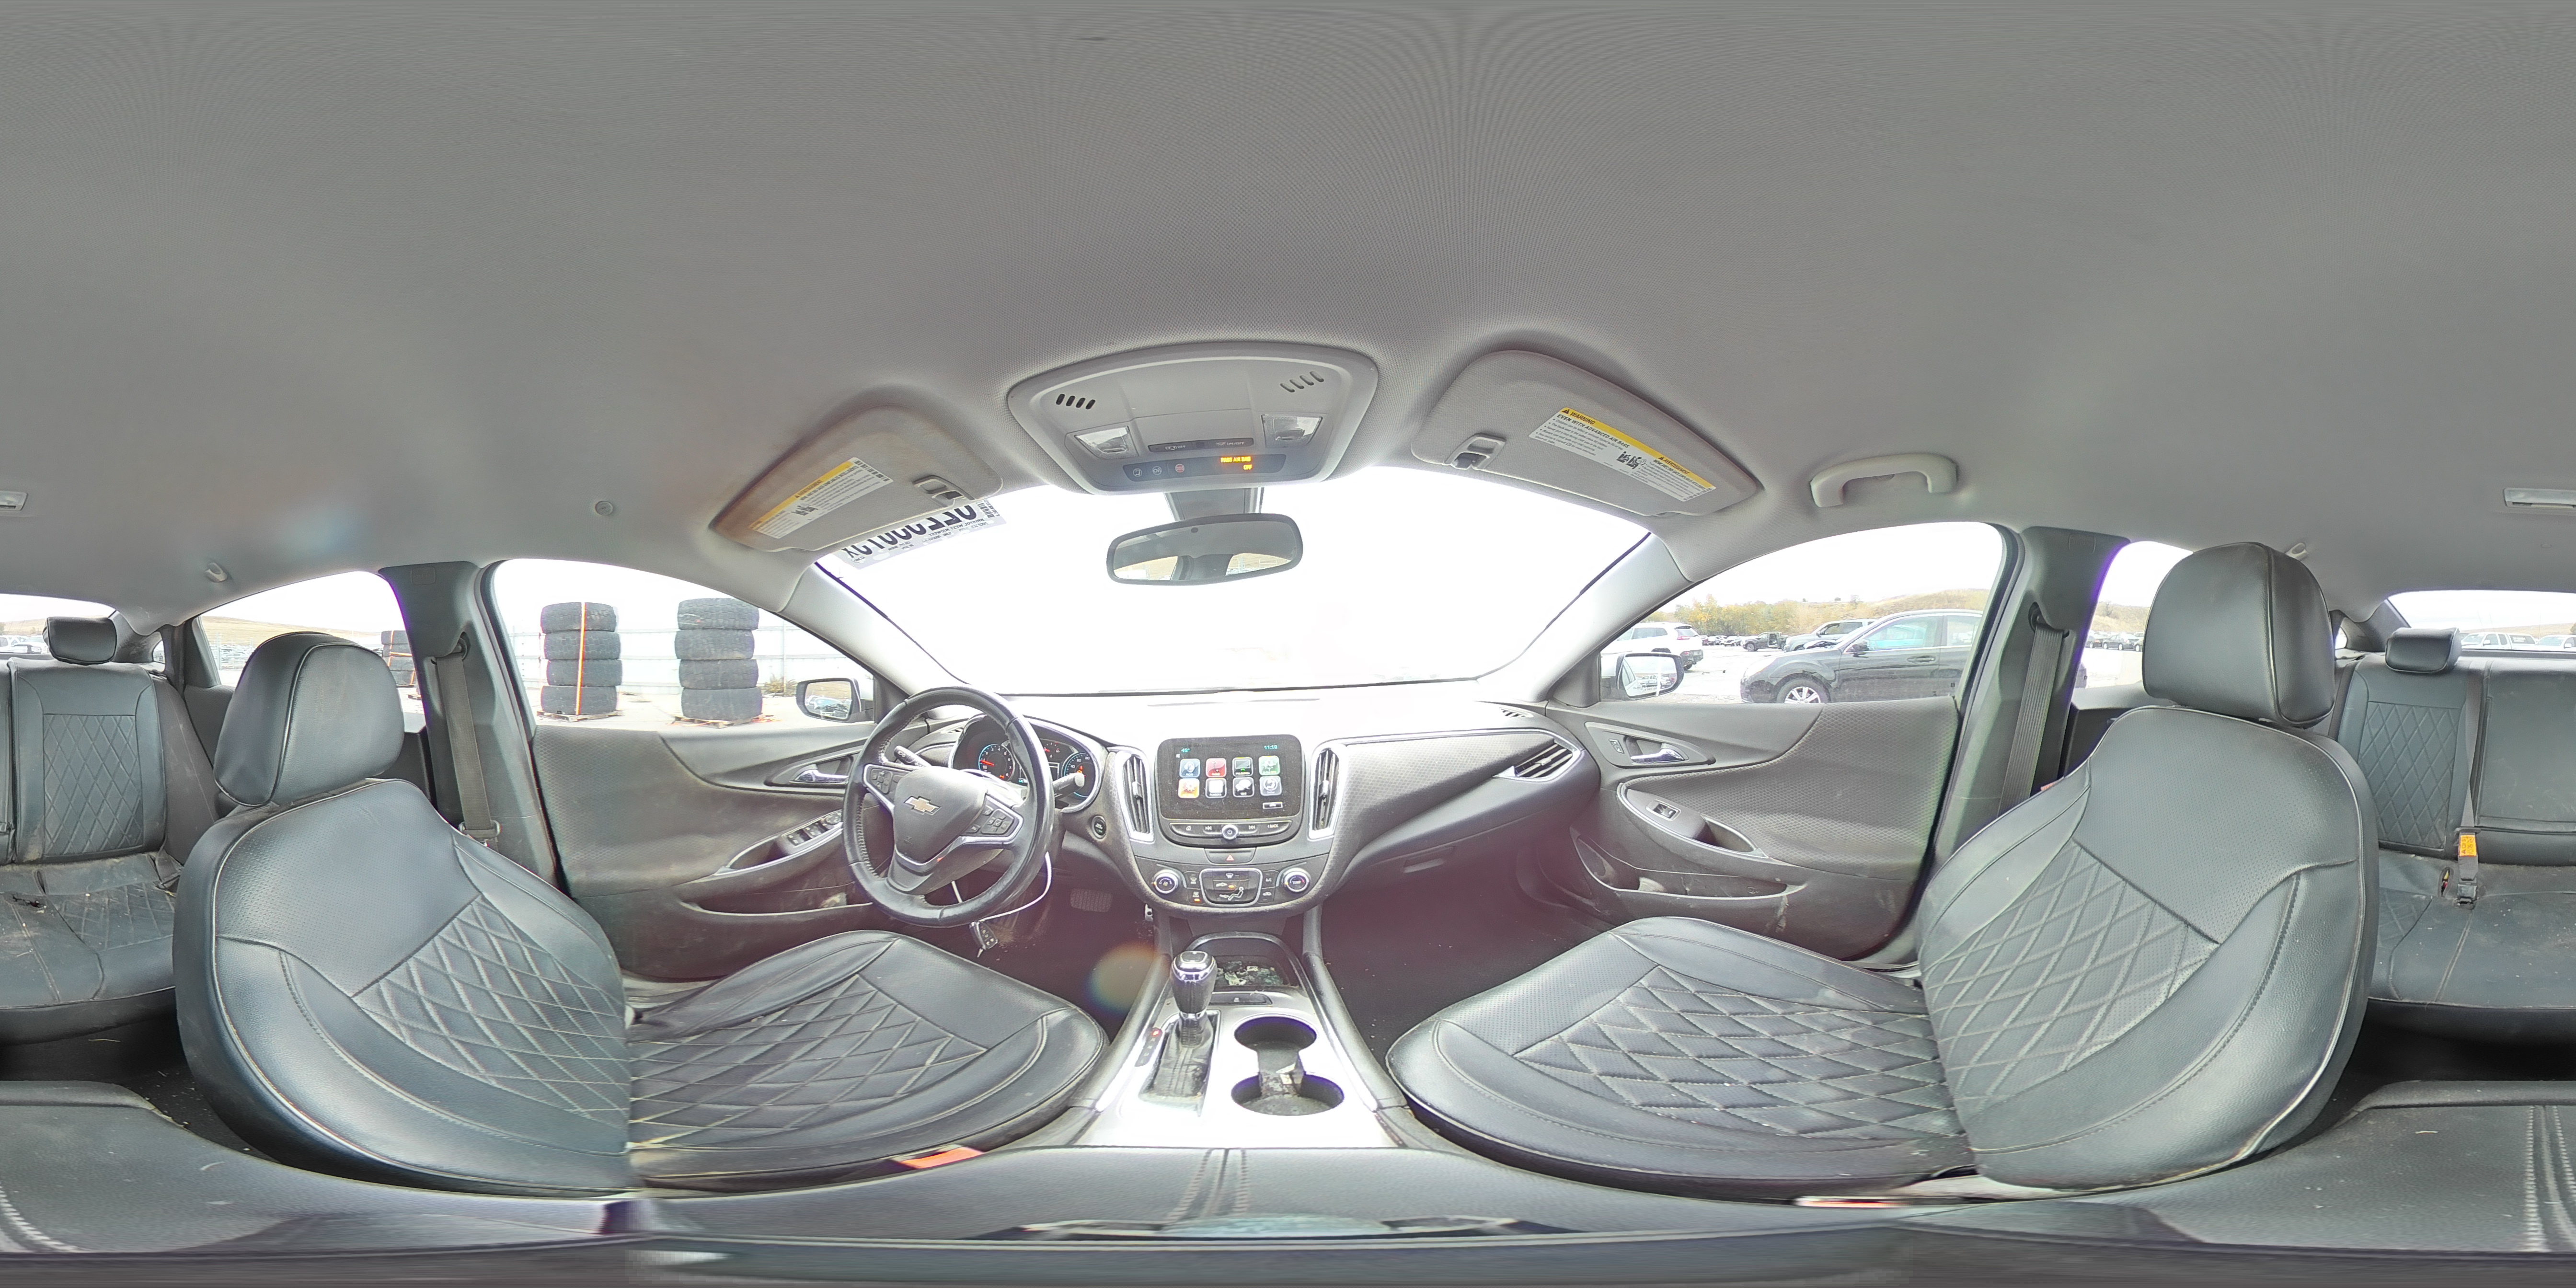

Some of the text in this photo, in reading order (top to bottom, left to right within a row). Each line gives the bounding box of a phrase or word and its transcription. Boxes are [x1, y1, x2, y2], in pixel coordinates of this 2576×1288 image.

[1570, 412, 1596, 425] WARNING
[1571, 419, 1586, 427] WITH
[1584, 426, 1610, 438] ADVANCED
[1609, 434, 1618, 443] AIR
[1617, 440, 1630, 448] BAGS
